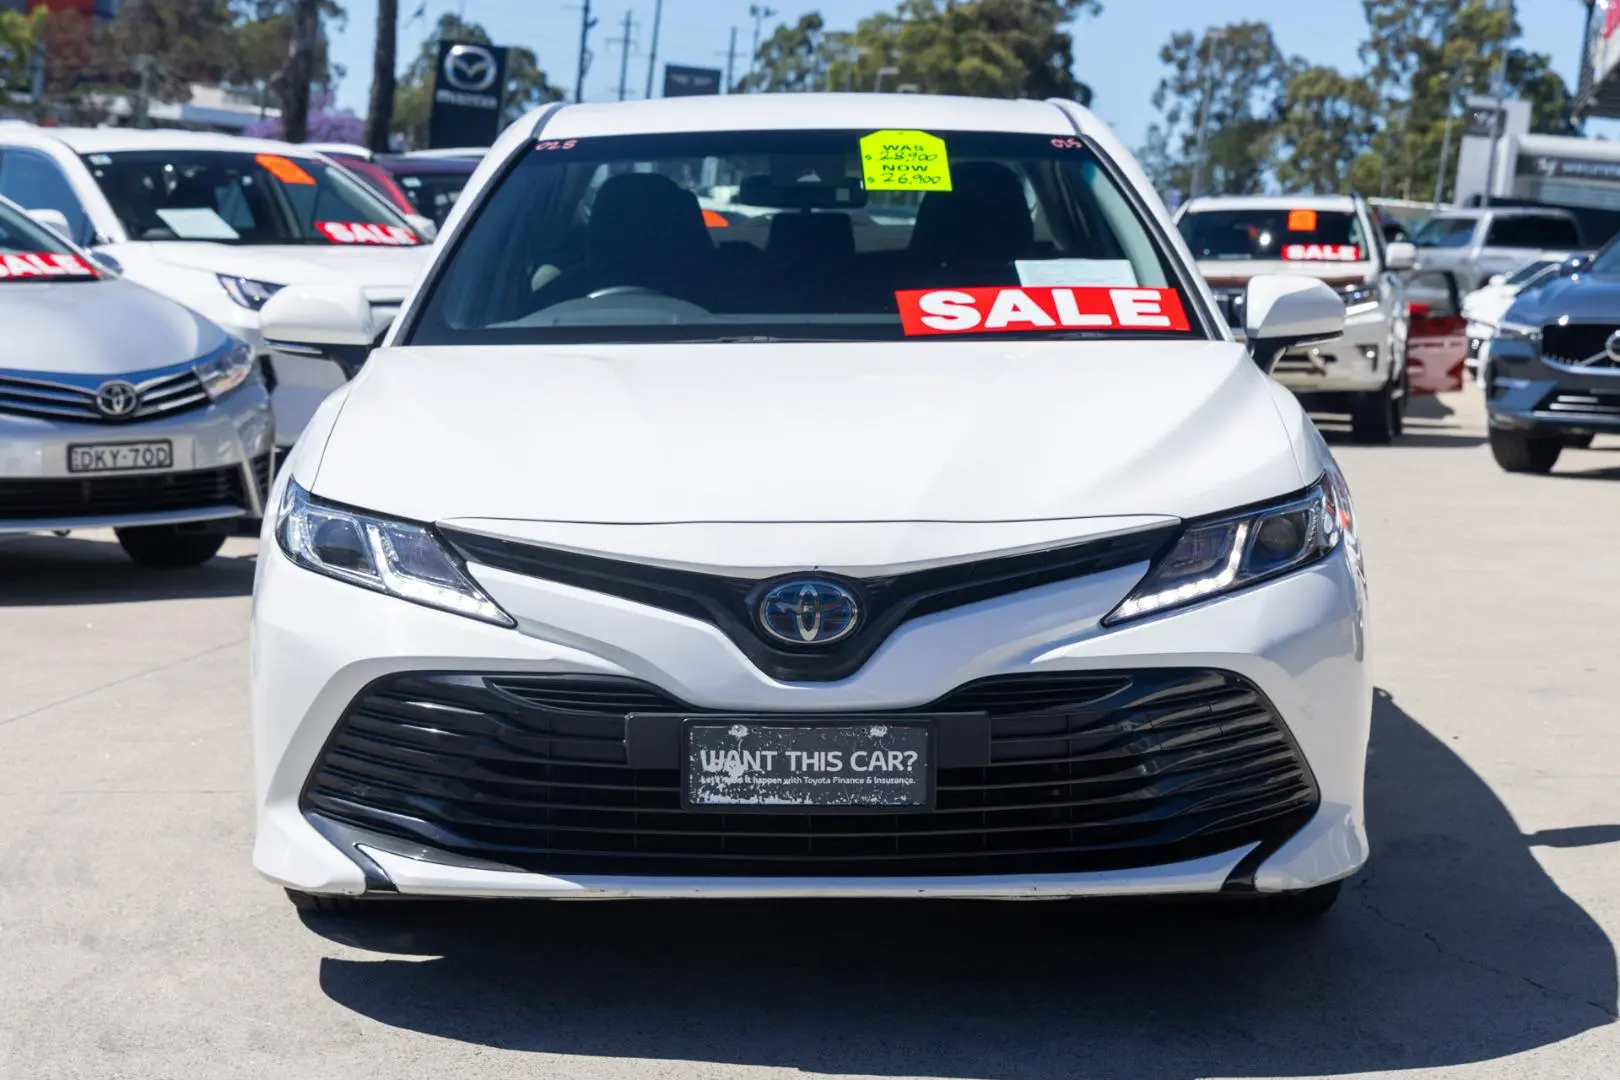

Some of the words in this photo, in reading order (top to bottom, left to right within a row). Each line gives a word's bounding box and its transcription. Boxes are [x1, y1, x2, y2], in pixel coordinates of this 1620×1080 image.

[882, 144, 925, 152] WAS
[882, 164, 928, 172] NOW
[323, 221, 418, 245] SALE
[1286, 244, 1355, 261] SALE
[919, 288, 1172, 331] SALE
[699, 749, 778, 773] WANT
[785, 750, 843, 772] THIS
[849, 750, 919, 772] CAR?
[752, 775, 782, 786] happen
[782, 775, 802, 785] with
[803, 776, 831, 786] Toyota
[832, 776, 864, 785] Finance
[865, 776, 872, 785] &
[873, 776, 917, 786] Insurance.
